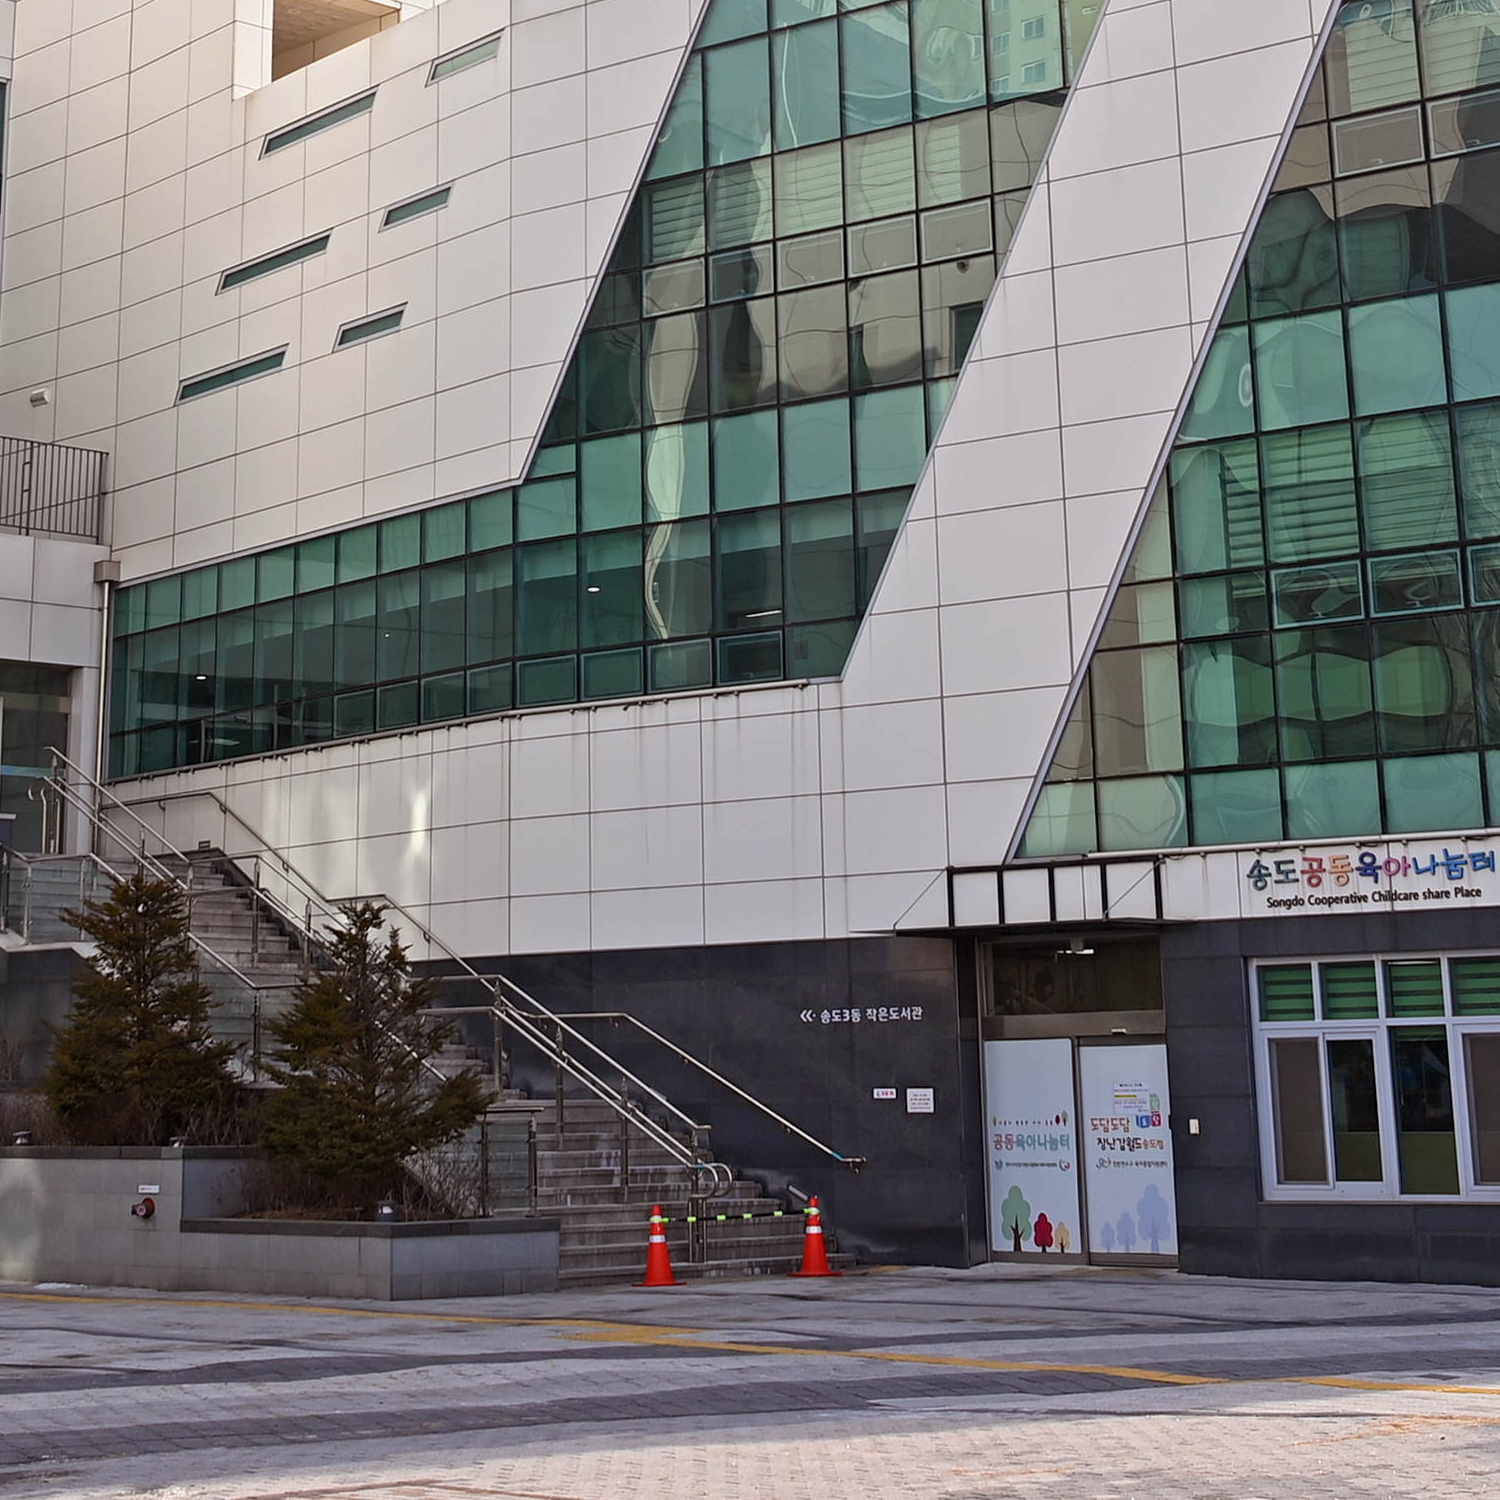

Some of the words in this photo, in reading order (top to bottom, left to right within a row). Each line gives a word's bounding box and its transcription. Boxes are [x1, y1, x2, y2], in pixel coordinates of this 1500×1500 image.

[1247, 848, 1496, 891] 송도공동육아나눔터
[1266, 895, 1305, 910] Songdo
[1308, 891, 1369, 908] Cooperative
[1371, 889, 1419, 903] Childcare
[1422, 887, 1451, 900] share
[1455, 885, 1482, 898] Place
[820, 1008, 861, 1024] 송도3동
[866, 1006, 923, 1022] 작은도서관
[1090, 1117, 1130, 1133] 도담도담
[993, 1133, 1070, 1151] 공동육아나눔터
[1096, 1137, 1142, 1152] 장난감월드
